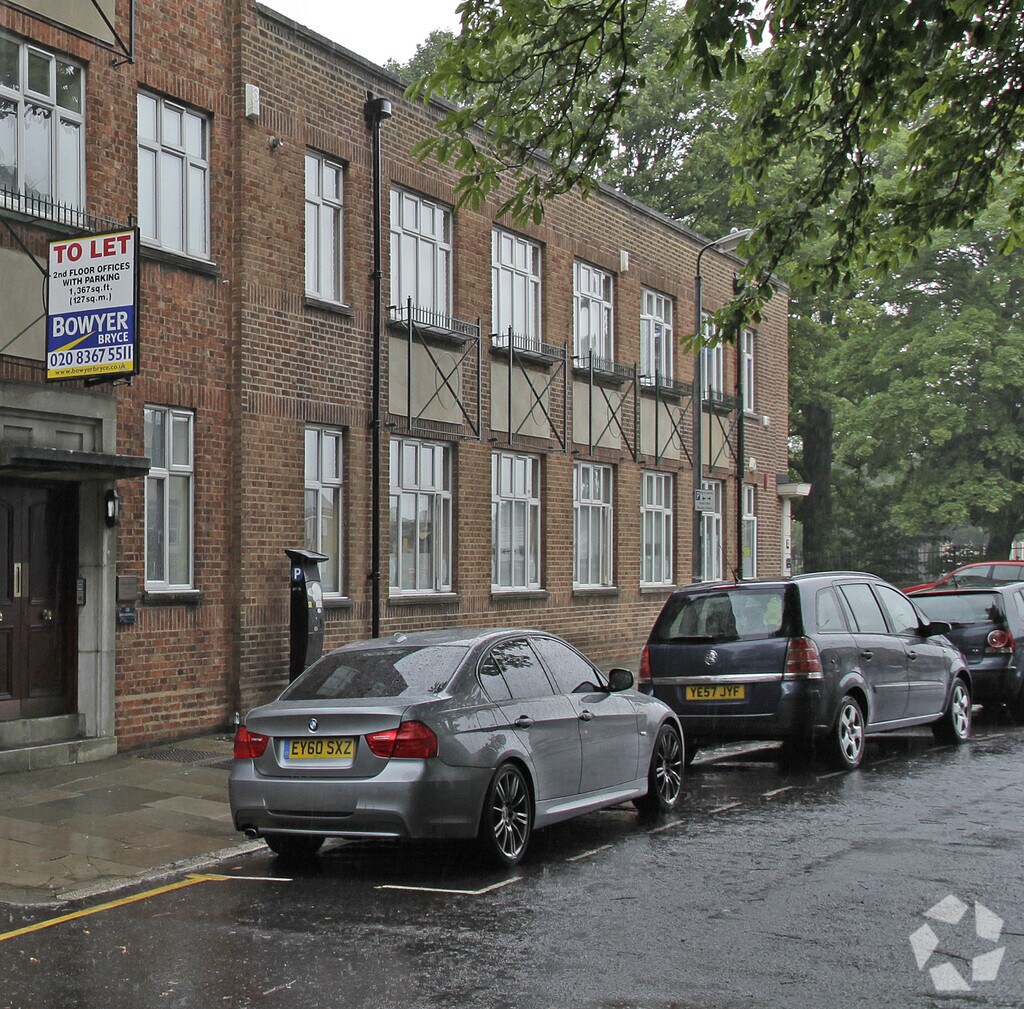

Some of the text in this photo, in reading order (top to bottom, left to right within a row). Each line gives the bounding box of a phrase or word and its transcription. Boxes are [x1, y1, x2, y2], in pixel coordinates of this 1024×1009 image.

[53, 235, 131, 263] TO LET
[53, 262, 130, 279] 2nd FLOOR OFFICES
[63, 273, 120, 286] WITH PARKING
[52, 311, 129, 338] BOWYER
[98, 332, 129, 345] BRYCE
[50, 346, 132, 367] 020 8367 5511
[54, 363, 126, 375] www.bowyerbryce.co.uk
[294, 567, 302, 580] P
[690, 686, 740, 698] YE57 JYF
[291, 739, 352, 755] EY60 SXZ
